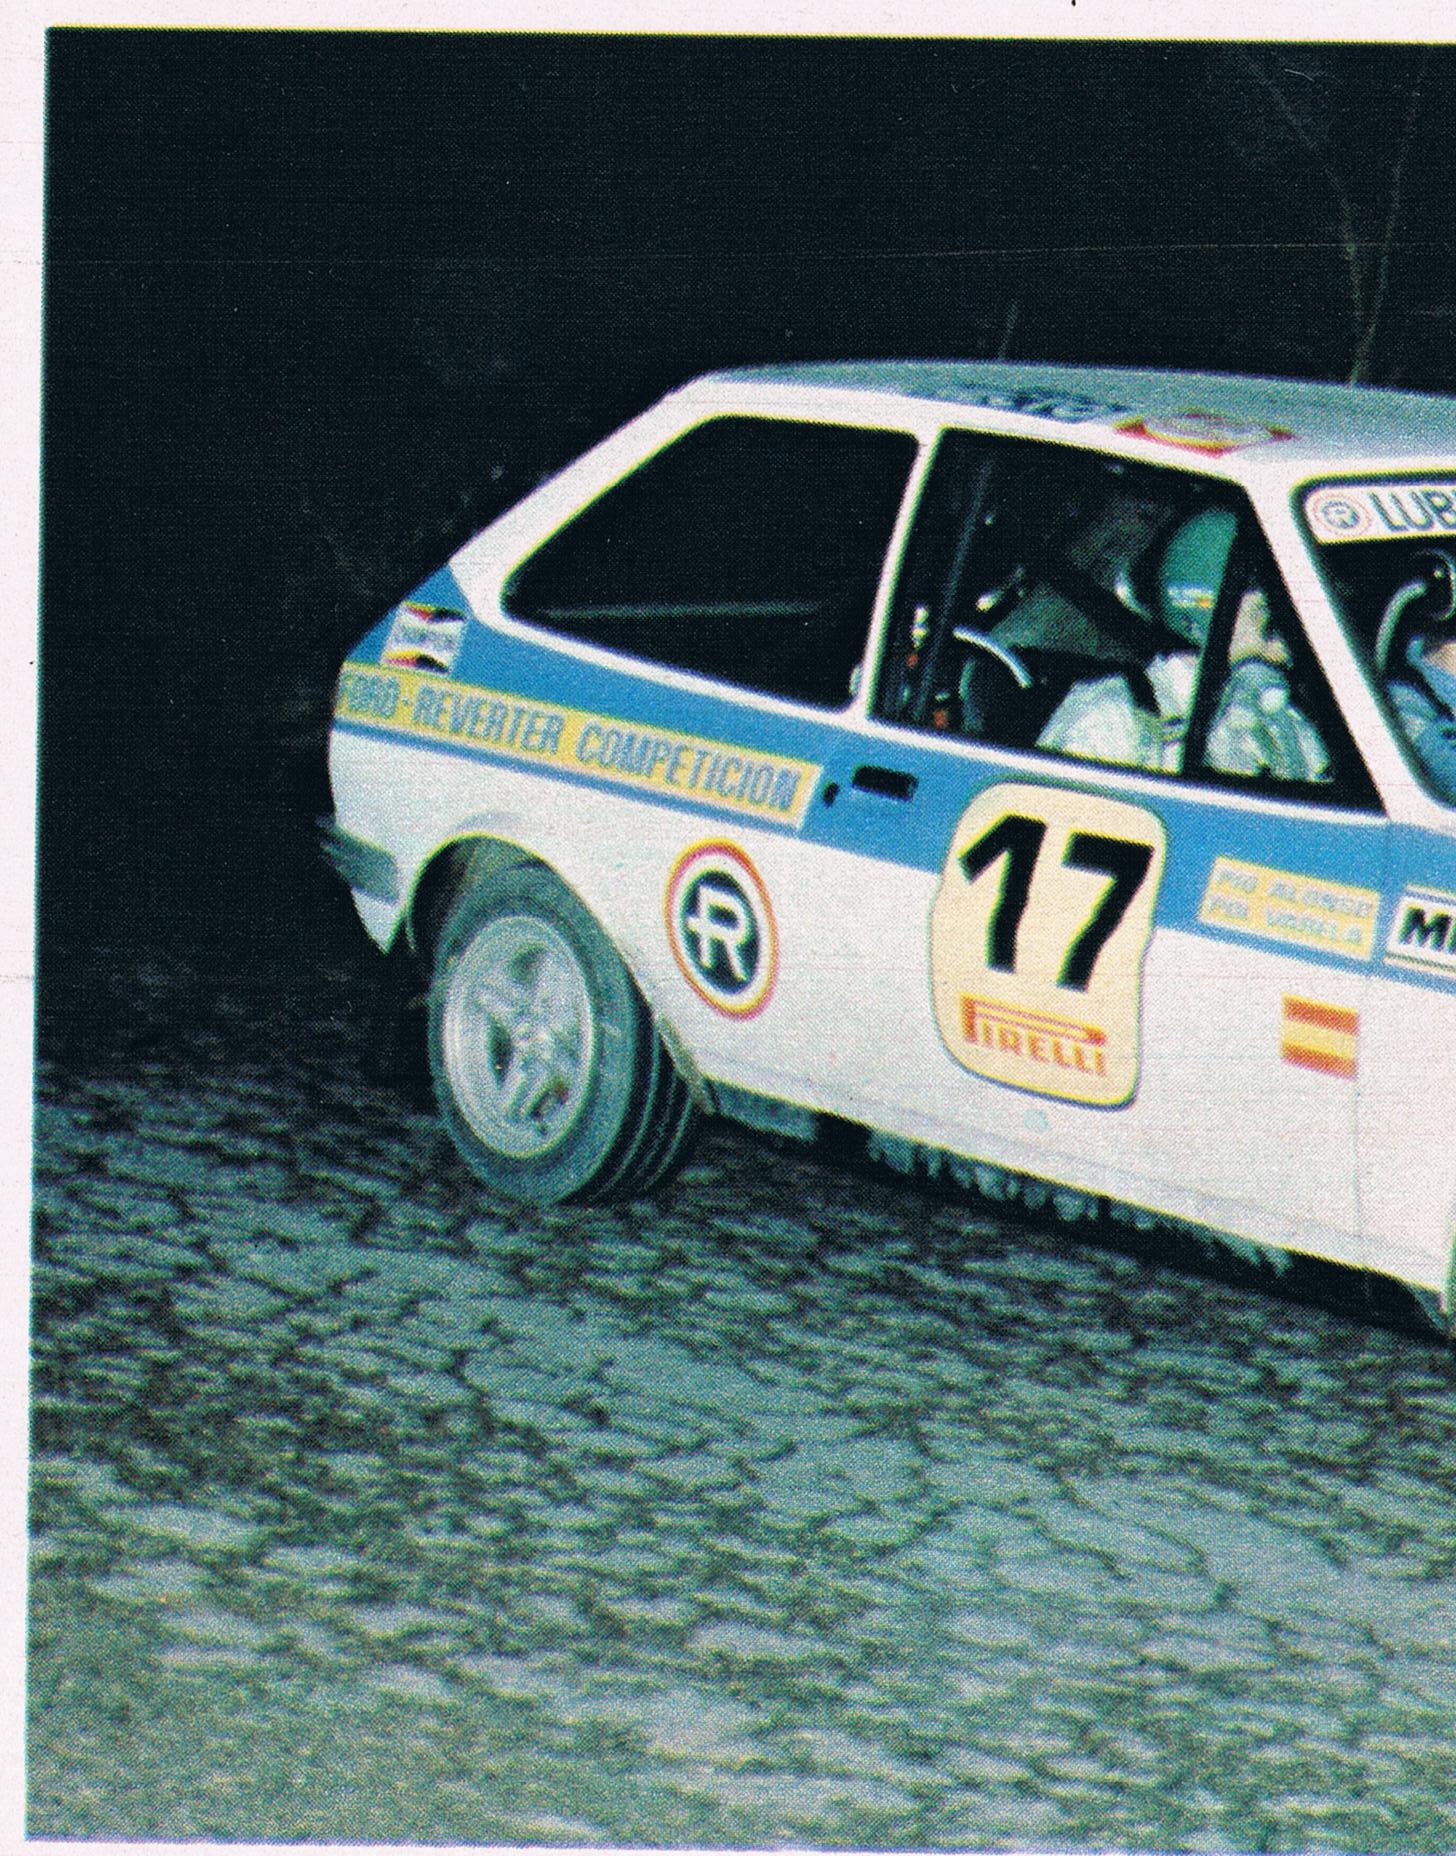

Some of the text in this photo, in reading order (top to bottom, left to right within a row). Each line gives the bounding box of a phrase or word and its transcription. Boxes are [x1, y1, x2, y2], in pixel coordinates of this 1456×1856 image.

[575, 718, 803, 812] COMPETICION
[957, 812, 1155, 993] 17
[959, 992, 1108, 1077] PIRELLI
